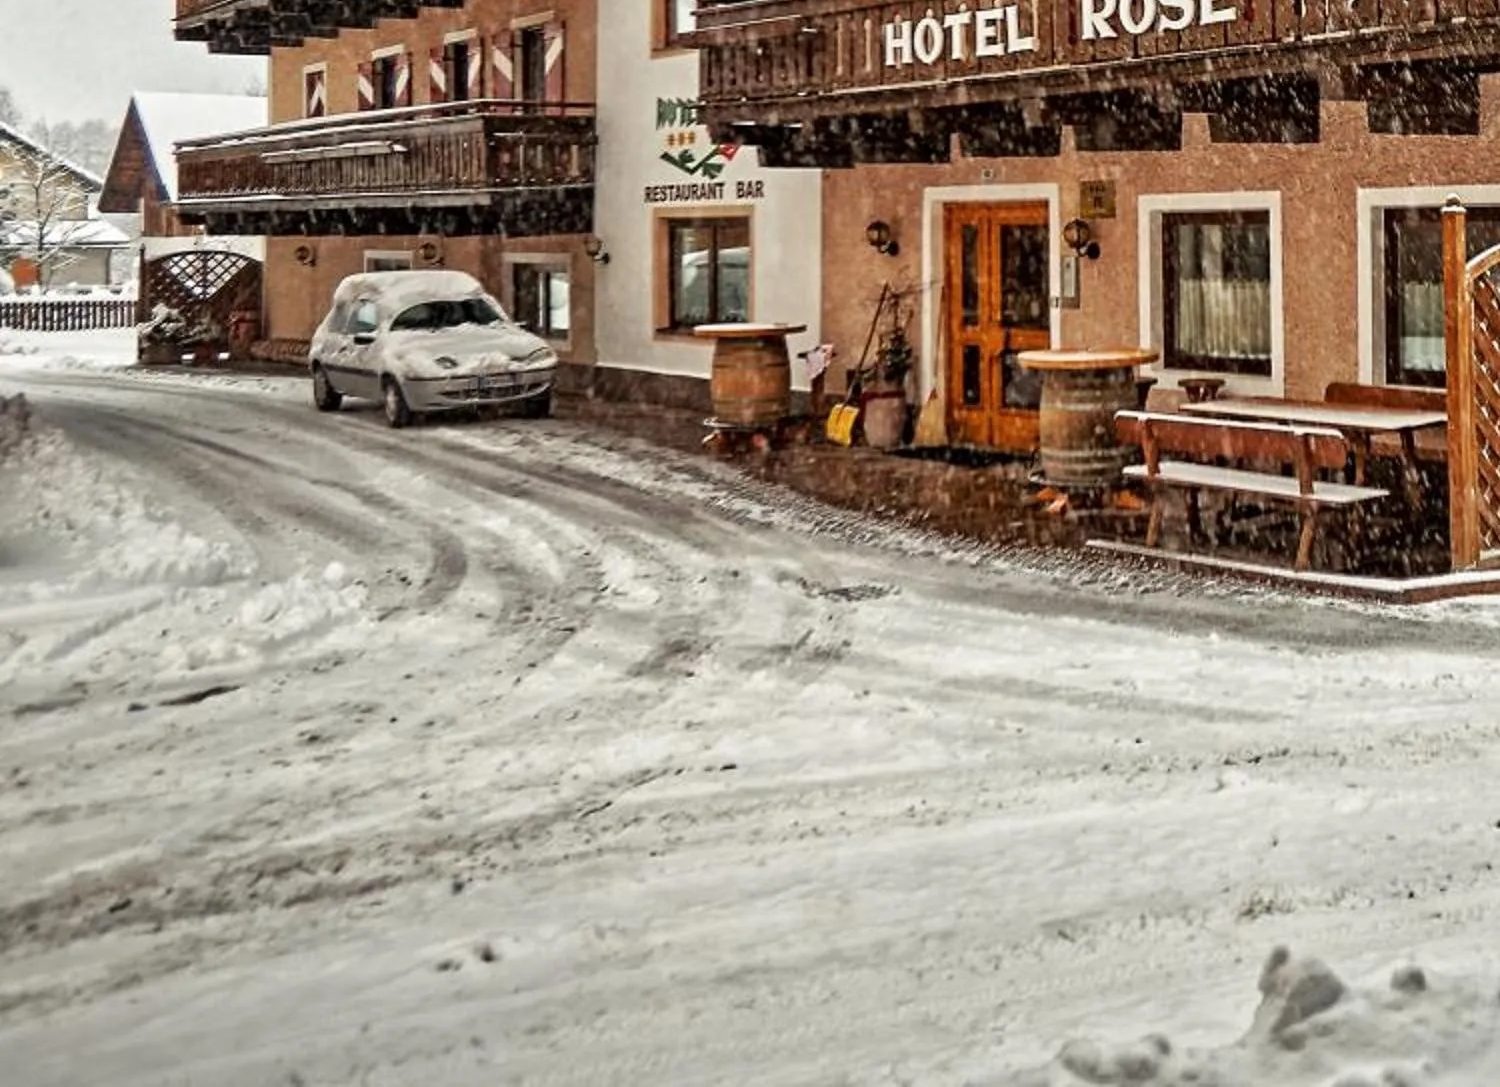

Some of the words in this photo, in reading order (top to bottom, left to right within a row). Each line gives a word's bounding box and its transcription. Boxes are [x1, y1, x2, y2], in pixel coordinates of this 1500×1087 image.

[884, 4, 1036, 66] HOTEL
[644, 183, 724, 202] RESTAURANT
[736, 181, 764, 198] BAR
